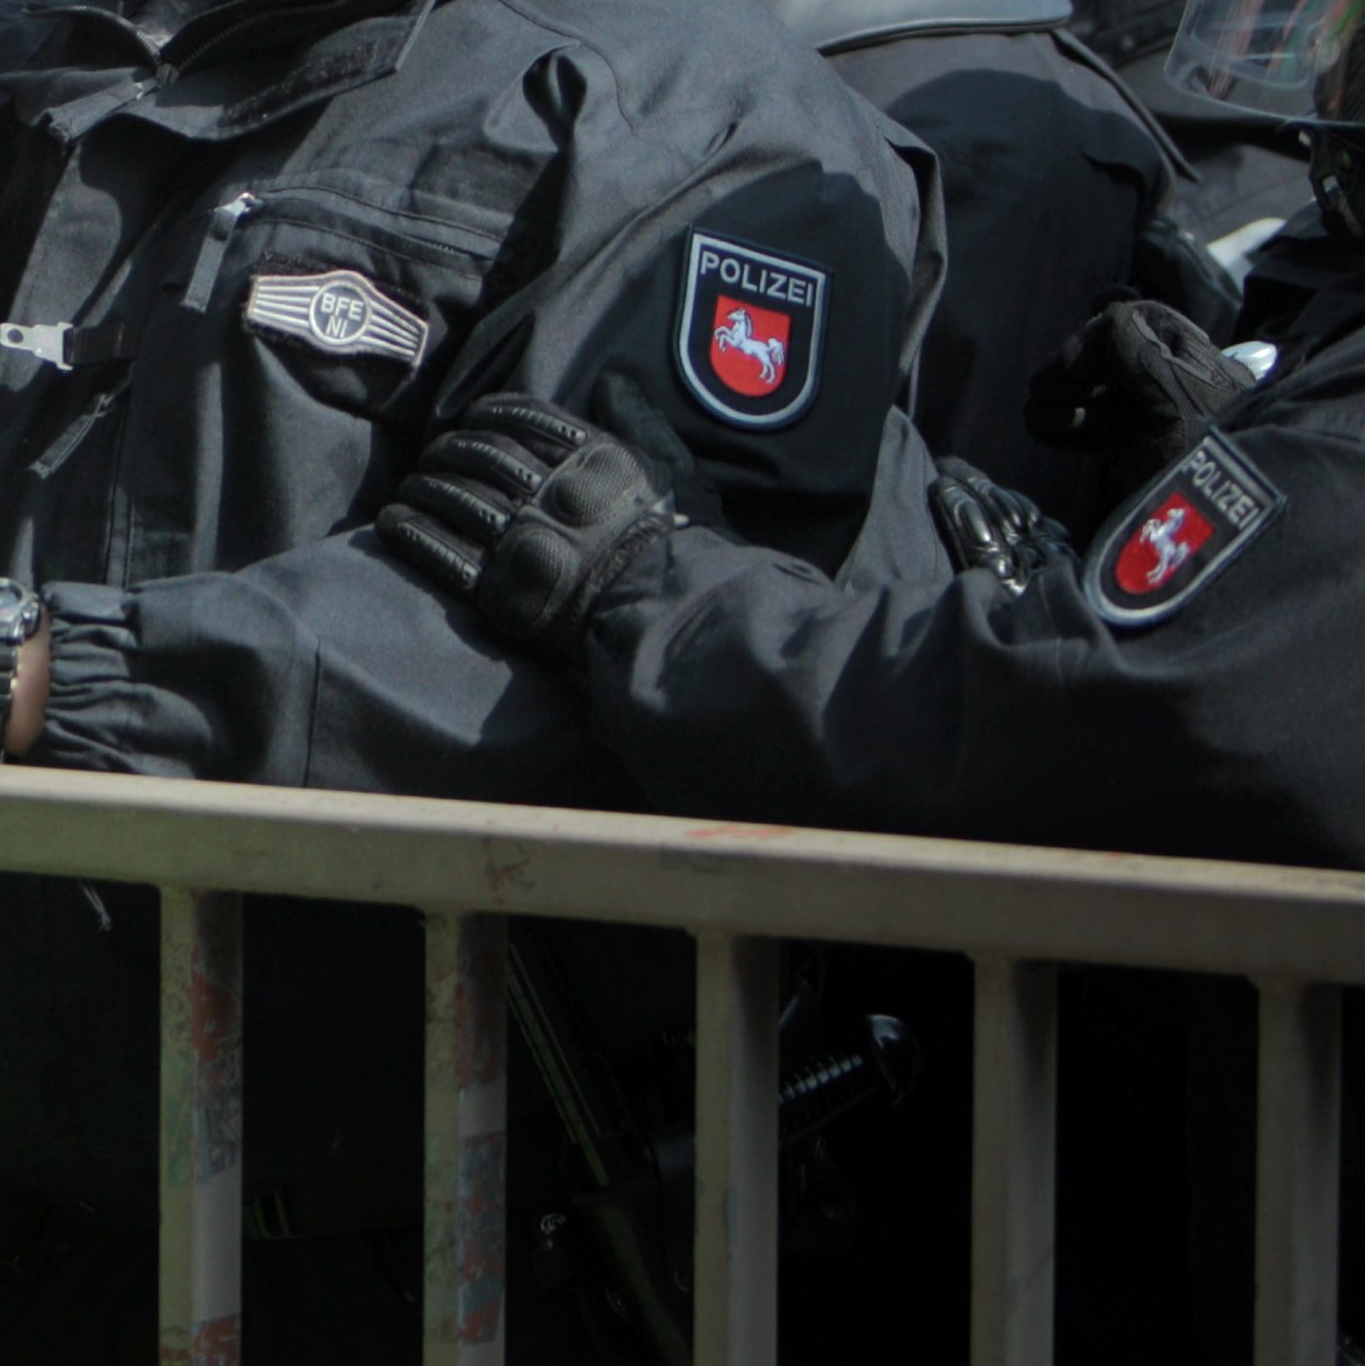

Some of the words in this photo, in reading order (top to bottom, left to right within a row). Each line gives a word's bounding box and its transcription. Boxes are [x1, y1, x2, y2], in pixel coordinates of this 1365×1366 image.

[699, 250, 815, 307] POLIZEI
[319, 292, 365, 322] BFE
[325, 315, 348, 339] NI
[1181, 449, 1261, 531] POLIZEI
